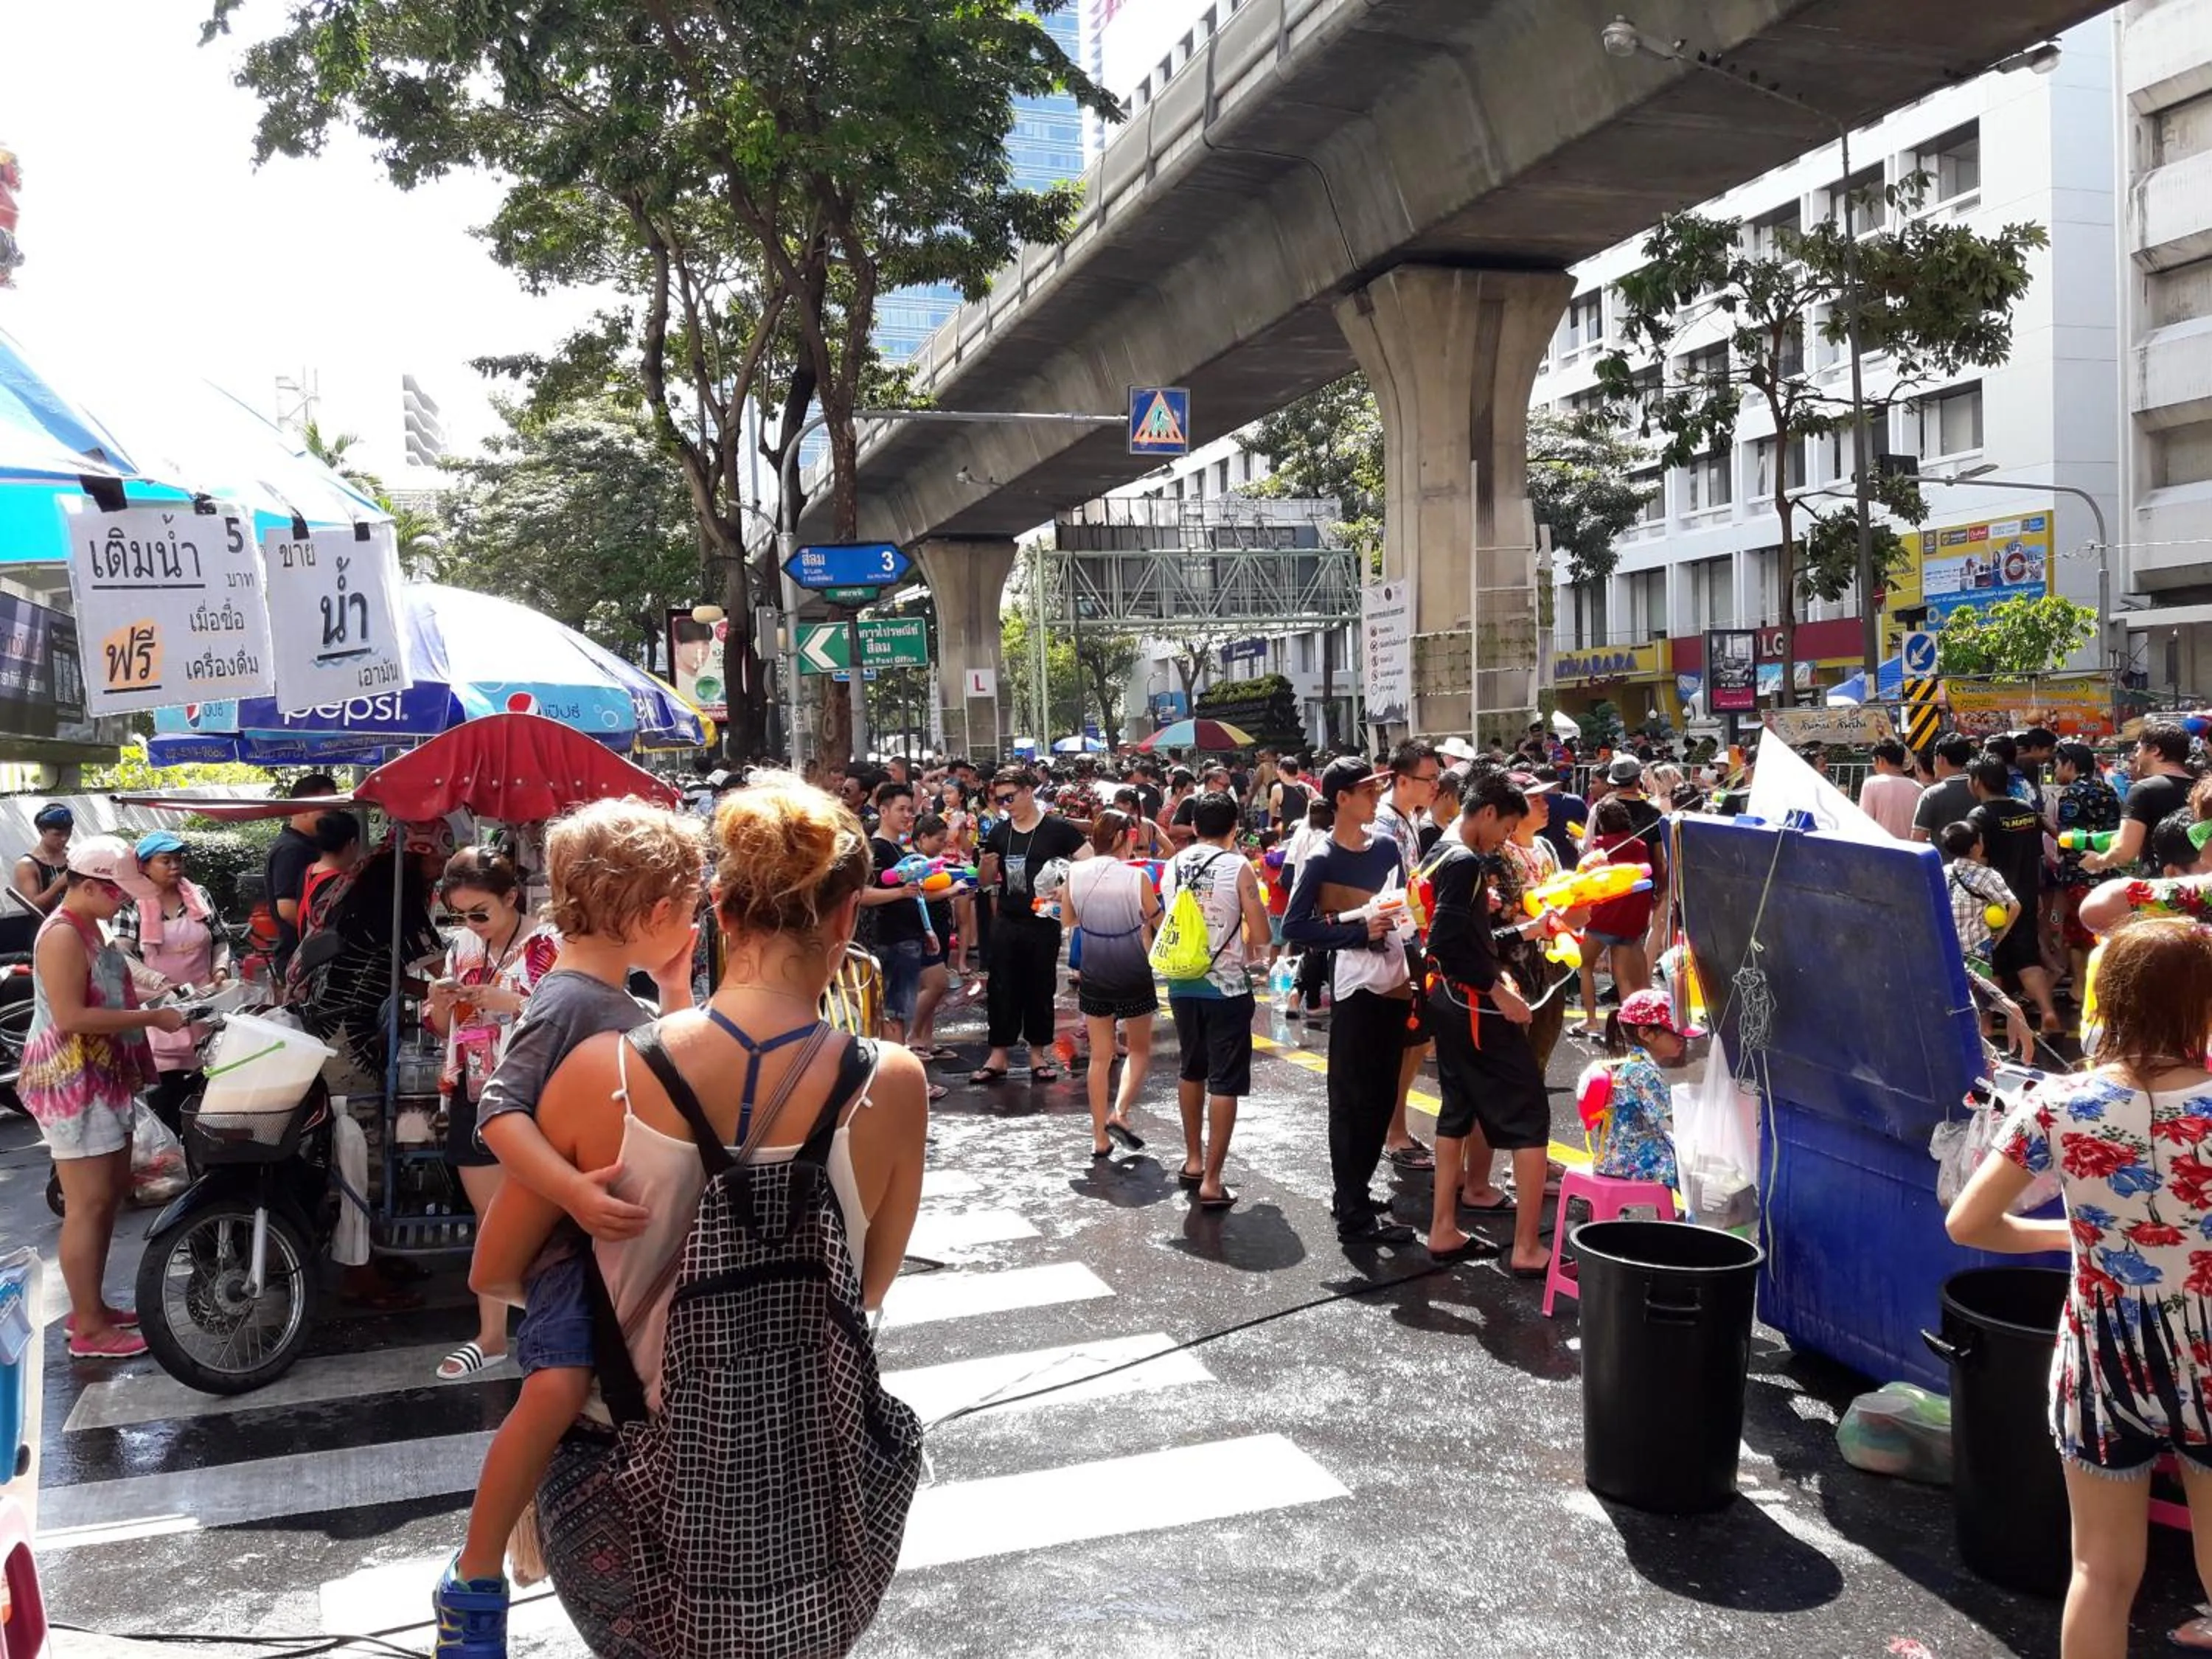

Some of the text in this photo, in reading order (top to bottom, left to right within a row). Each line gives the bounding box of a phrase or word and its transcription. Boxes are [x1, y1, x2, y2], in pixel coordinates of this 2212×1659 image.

[89, 513, 201, 578] เติมน้ำ
[225, 517, 243, 553] 5
[279, 543, 316, 568] ขาย
[881, 551, 894, 571] 3
[227, 571, 254, 588] บาท
[320, 556, 367, 647] น้ำ
[189, 597, 245, 632] เมื่อซื้อ
[105, 626, 156, 682] ฟรี
[866, 638, 891, 654] สีลม
[1761, 633, 1784, 657] LG
[186, 644, 260, 680] เครื่องดื่ม
[894, 655, 917, 664] Office
[975, 674, 987, 692] L
